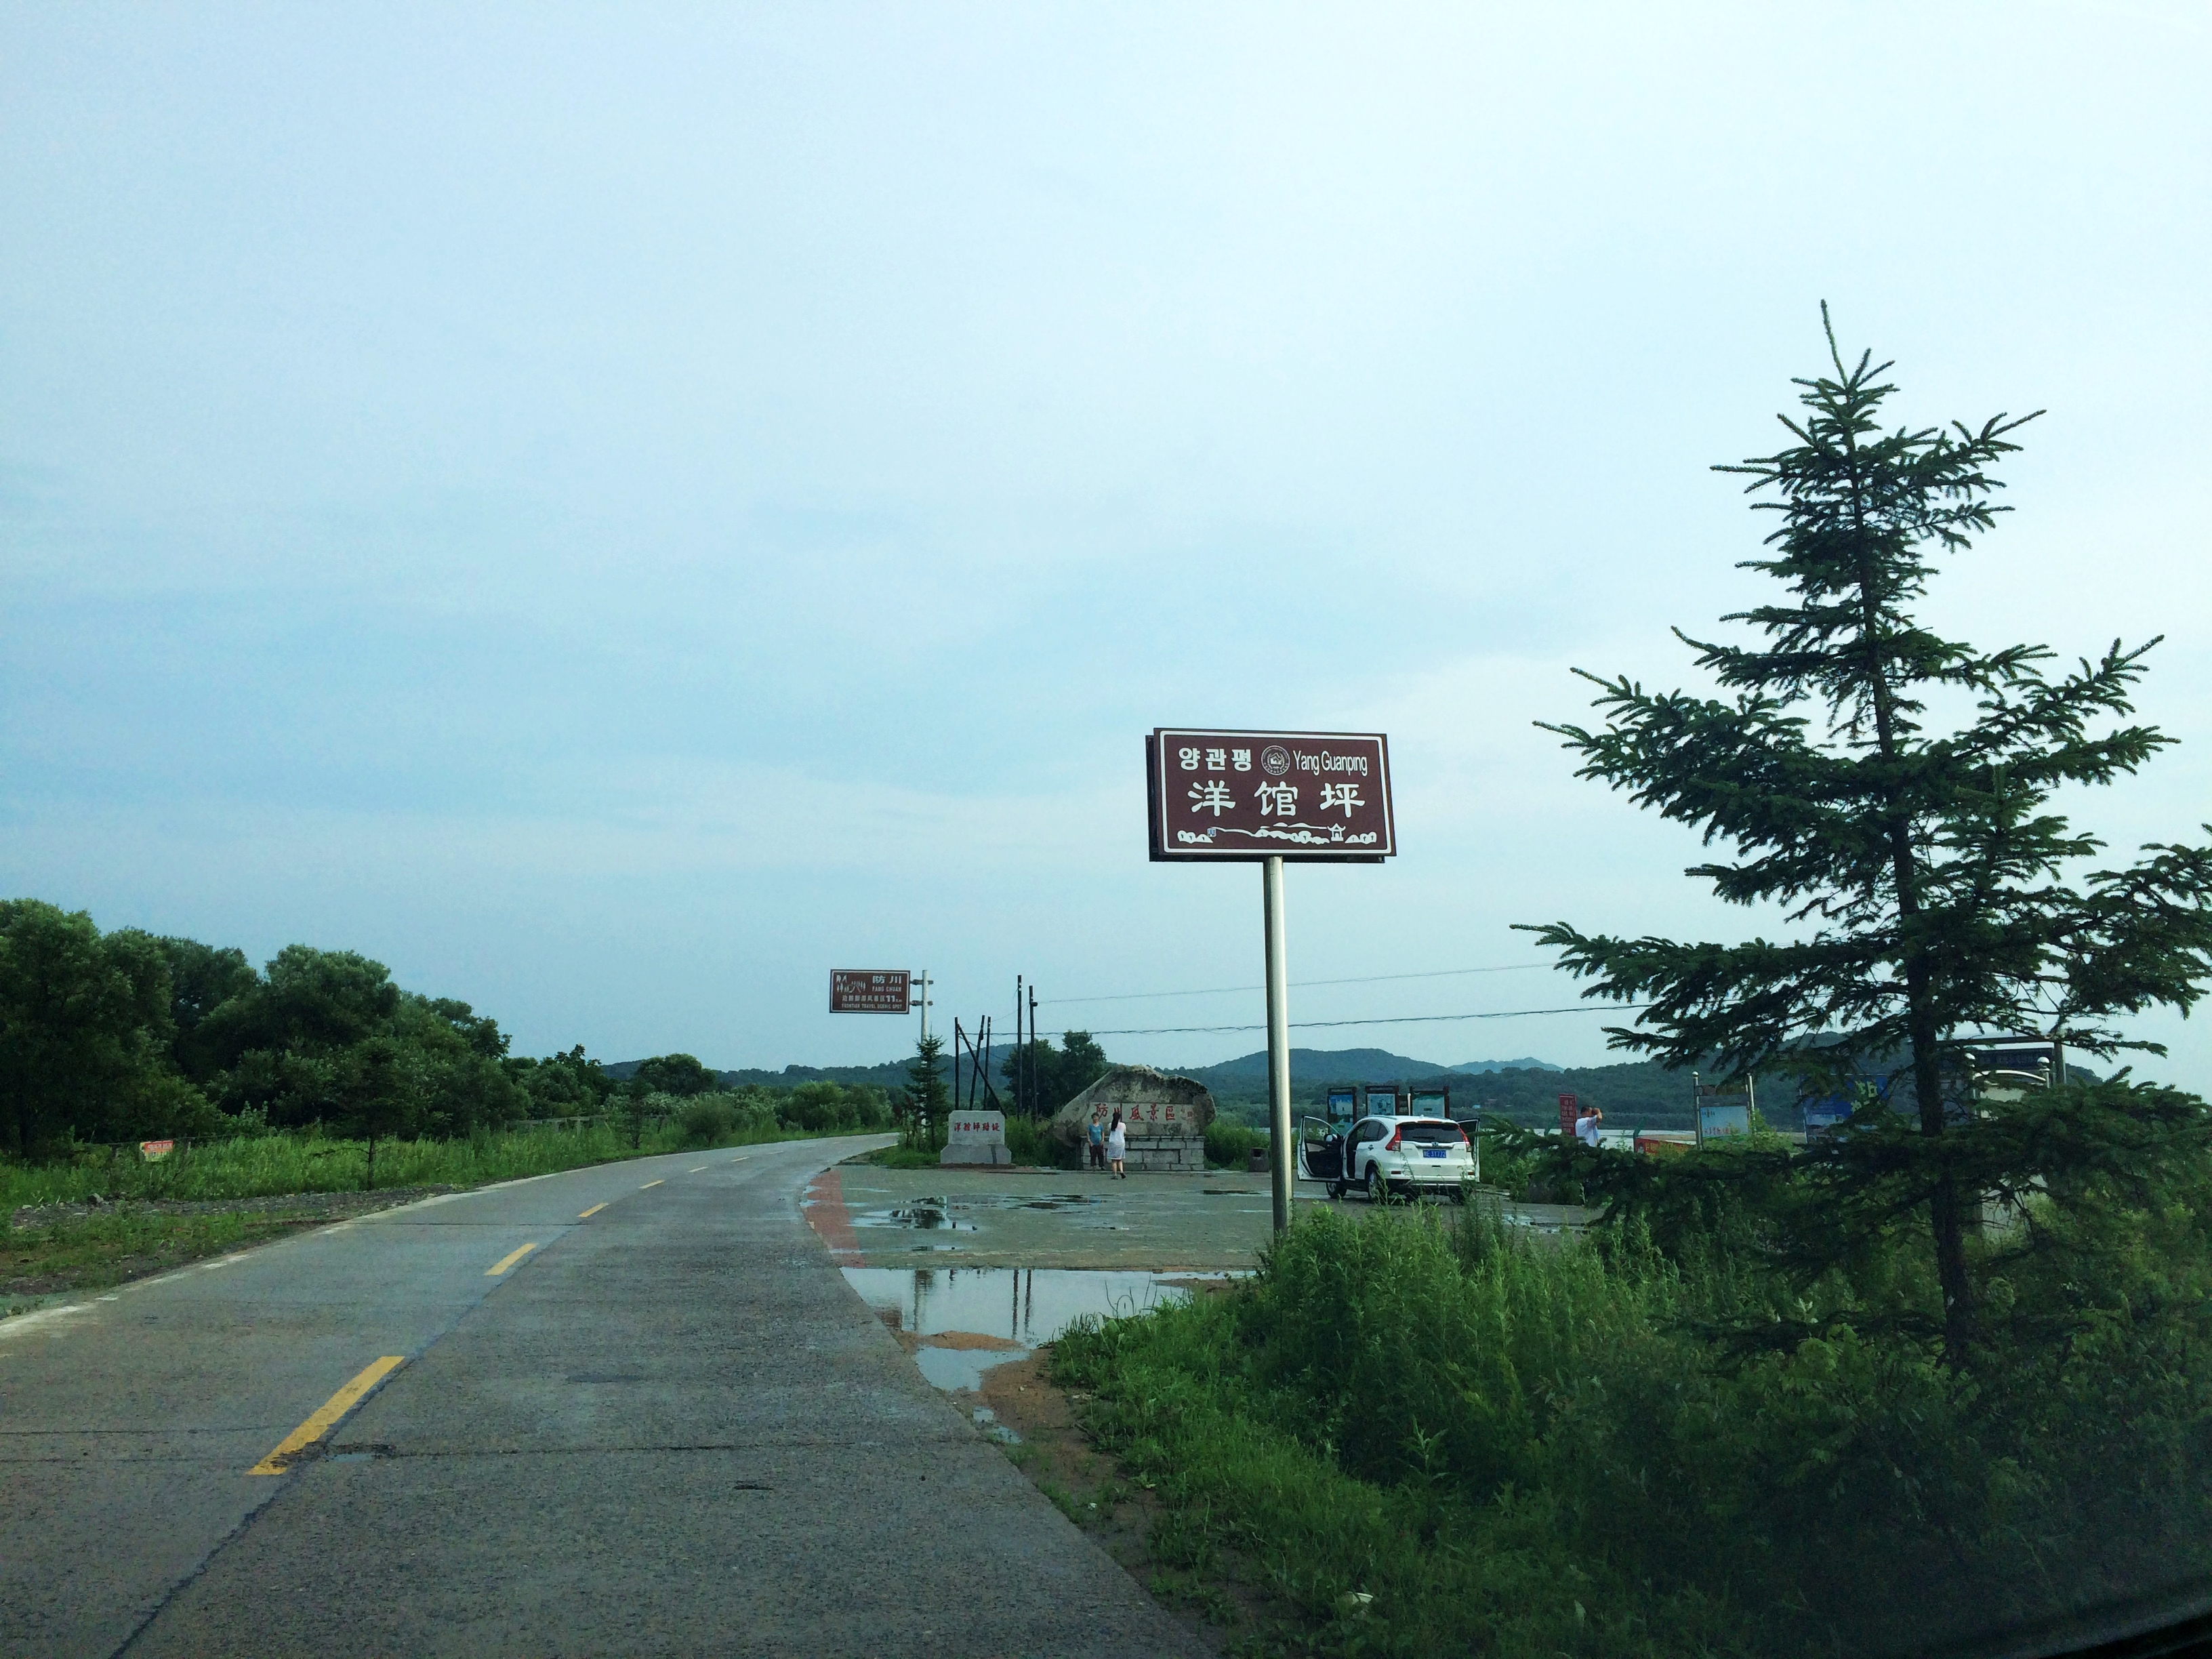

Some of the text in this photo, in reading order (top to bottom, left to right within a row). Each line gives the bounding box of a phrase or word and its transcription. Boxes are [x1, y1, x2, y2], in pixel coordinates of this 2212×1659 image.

[1178, 747, 1252, 772] 양관평
[1292, 750, 1319, 777] Yang
[1321, 750, 1368, 777] Guanping
[1187, 779, 1366, 818] 洋馆坪
[872, 975, 902, 984] 防川
